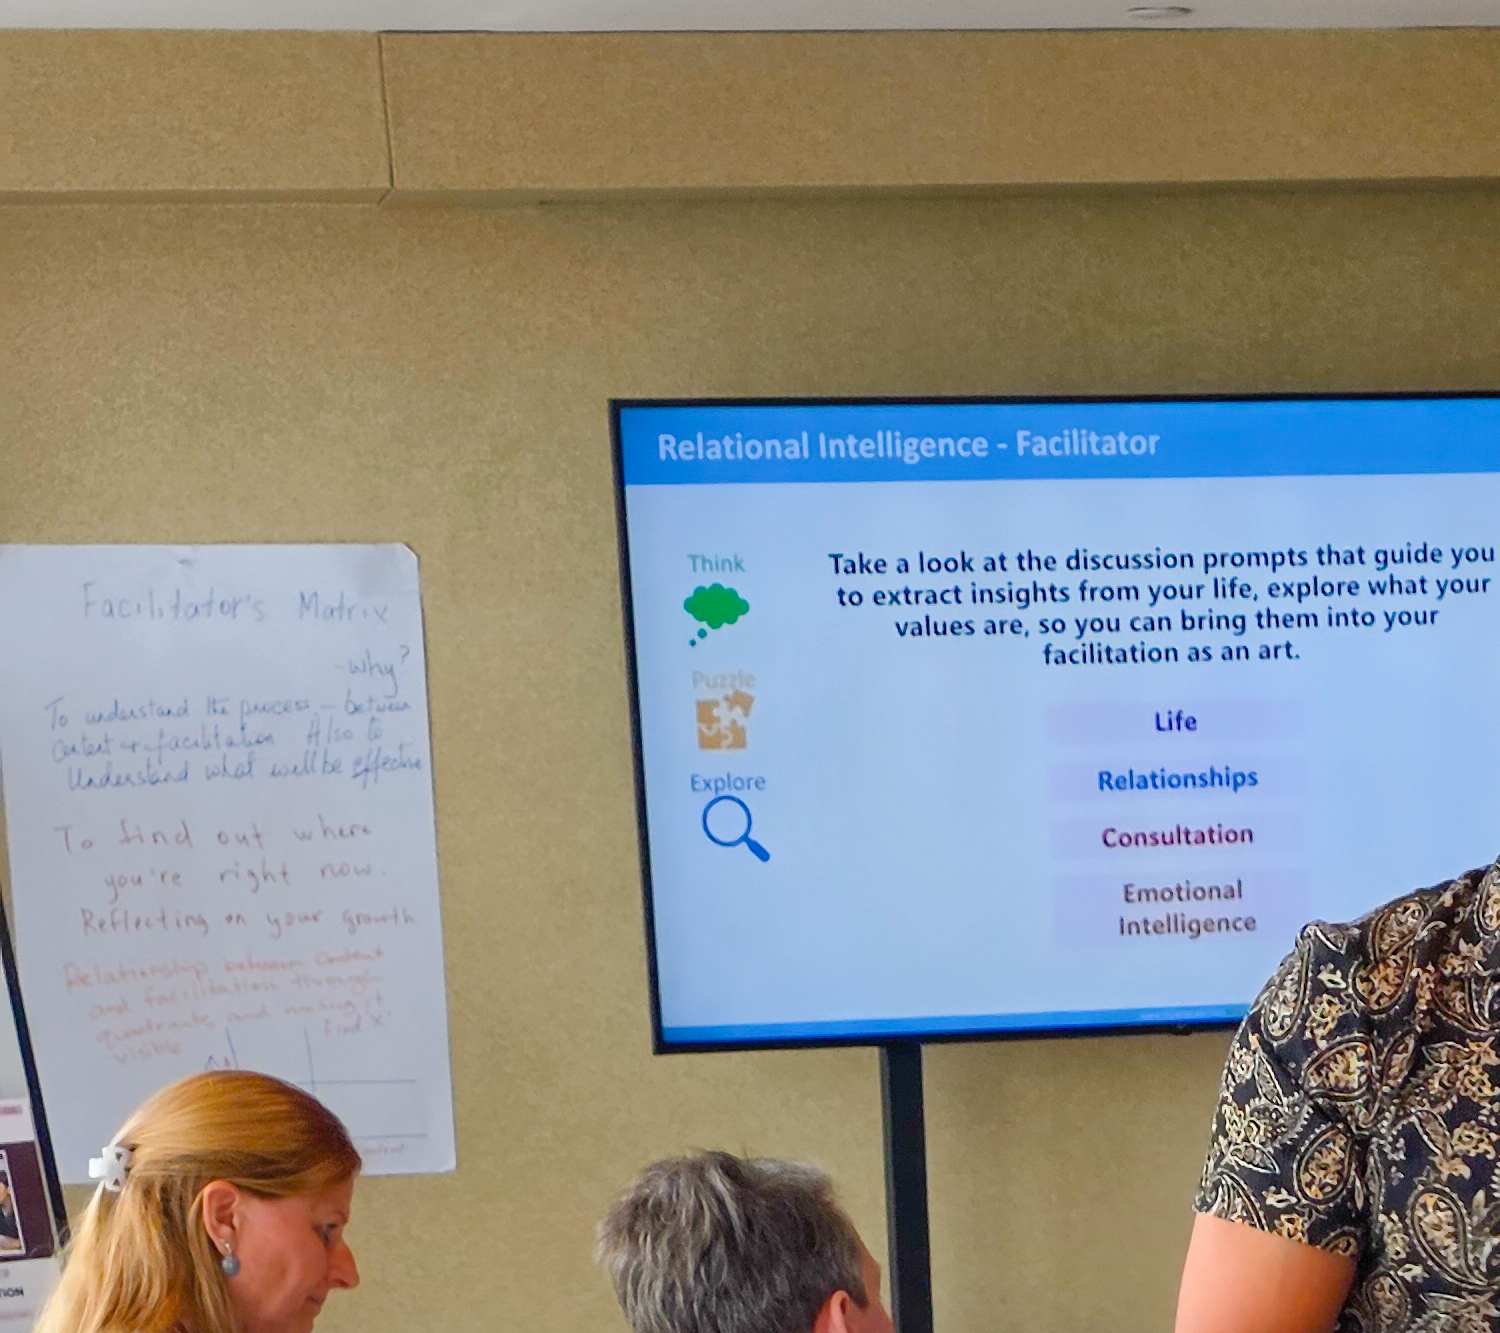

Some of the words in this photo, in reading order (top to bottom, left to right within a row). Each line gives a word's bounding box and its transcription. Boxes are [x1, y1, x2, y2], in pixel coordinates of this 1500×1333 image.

[658, 432, 809, 461] Relational
[819, 429, 988, 464] Intelligence
[1016, 428, 1160, 457] Facilitator
[687, 553, 745, 574] Think
[828, 552, 887, 575] Take
[896, 559, 910, 574] a
[918, 550, 974, 573] look
[983, 554, 1008, 573] at
[1016, 550, 1057, 572] the
[1065, 547, 1194, 571] discussion
[1203, 549, 1308, 574] prompts
[1316, 544, 1366, 566] that
[1374, 542, 1443, 571] guide
[1450, 545, 1495, 566] you
[82, 582, 265, 623] Facilitator's
[298, 591, 388, 623] Matrix
[836, 586, 862, 607] to
[872, 585, 962, 606] extract
[971, 582, 1070, 609] insights
[1079, 579, 1139, 602] from
[1148, 583, 1204, 606] your
[1213, 577, 1259, 602] life,
[1267, 577, 1360, 602] explore
[1368, 574, 1428, 596] what
[1436, 577, 1491, 601] your
[894, 614, 976, 637] values
[983, 616, 1029, 638] are,
[1038, 617, 1066, 635] so
[1074, 616, 1121, 638] you
[1129, 614, 1172, 633] can
[1181, 609, 1247, 636] bring
[1256, 608, 1319, 630] them
[1327, 606, 1375, 628] into
[1383, 609, 1439, 632] your
[1043, 641, 1178, 666] facilitation
[1186, 645, 1213, 662] as
[1220, 644, 1250, 662] an
[1258, 641, 1300, 662] art.
[692, 670, 756, 692] Puzzle
[45, 697, 68, 728] To
[86, 700, 189, 726] understand
[1155, 709, 1198, 732] Life
[206, 757, 254, 781] what
[1098, 766, 1258, 792] Relationships
[690, 772, 765, 795] Explore
[54, 825, 94, 854] To
[119, 819, 193, 849] find
[217, 823, 264, 849] out
[294, 815, 372, 842] where
[1102, 823, 1254, 848] Consultation
[104, 869, 181, 901] you're
[219, 859, 289, 893] right
[1123, 879, 1243, 903] Emotional
[81, 908, 209, 937] Reflecting
[225, 913, 247, 927] on
[266, 911, 321, 938] your
[342, 907, 416, 936] growth
[1119, 912, 1257, 939] Intelligence
